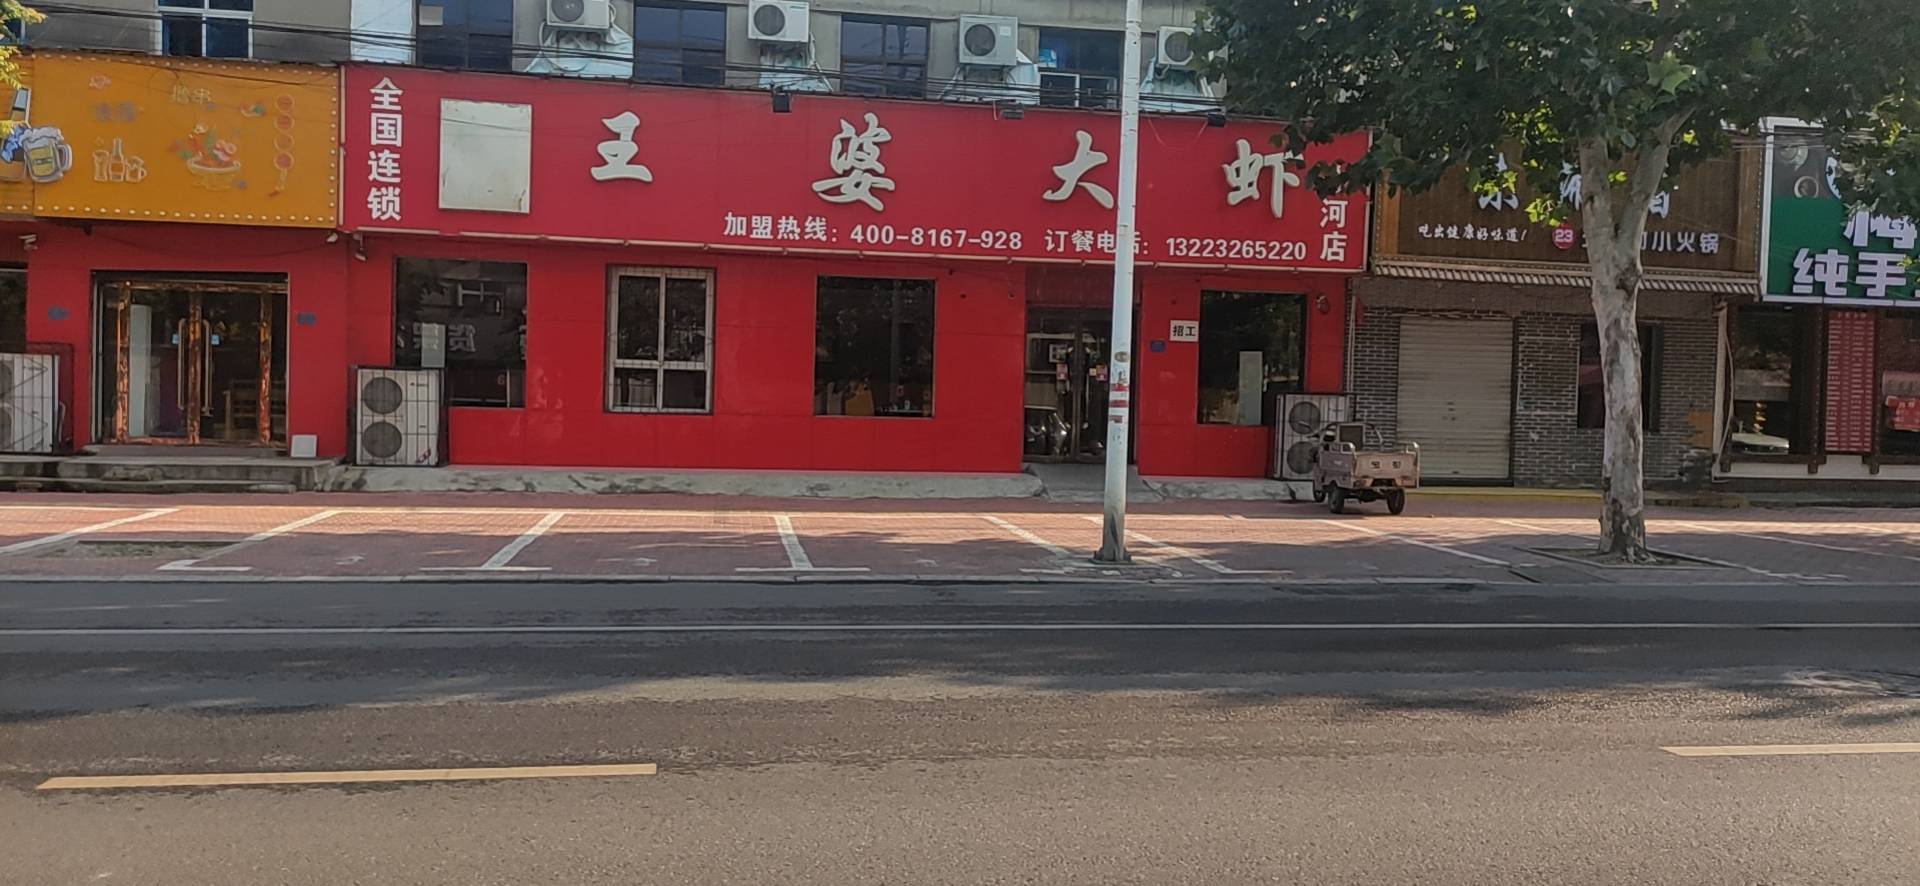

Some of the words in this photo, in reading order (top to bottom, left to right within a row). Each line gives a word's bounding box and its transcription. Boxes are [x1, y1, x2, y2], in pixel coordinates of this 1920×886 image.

[367, 77, 403, 222] 全国连锁
[590, 111, 1304, 218] 王婆大虾
[850, 225, 1022, 251] 400-8167-928
[1044, 229, 1149, 255] 订餐电：
[1166, 237, 1307, 261] 13223265220
[1319, 164, 1349, 262] 河店
[1792, 248, 1920, 298] 纯手
[1172, 325, 1196, 337] 招工
